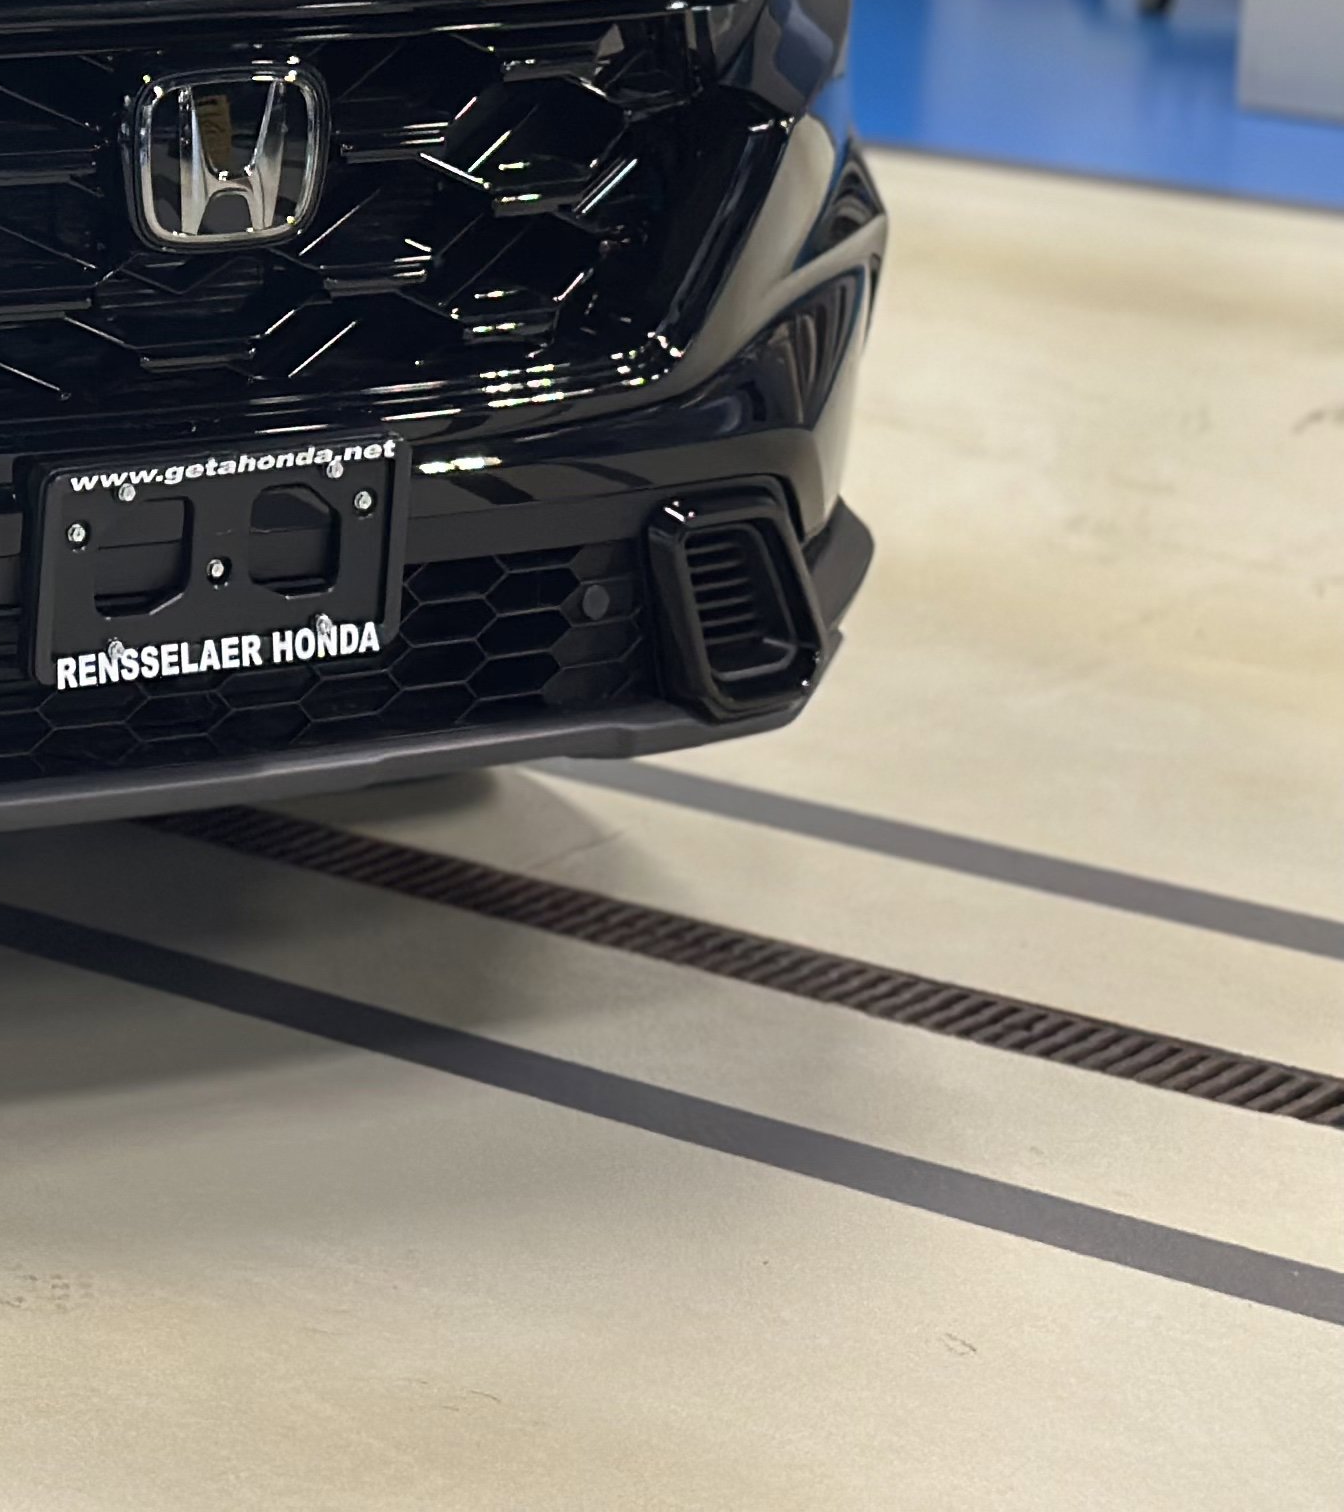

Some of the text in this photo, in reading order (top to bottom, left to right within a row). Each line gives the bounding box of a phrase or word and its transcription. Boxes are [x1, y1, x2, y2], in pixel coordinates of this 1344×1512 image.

[69, 439, 397, 492] www.getahonda.net
[56, 621, 381, 691] RENSSELAER HONDA
